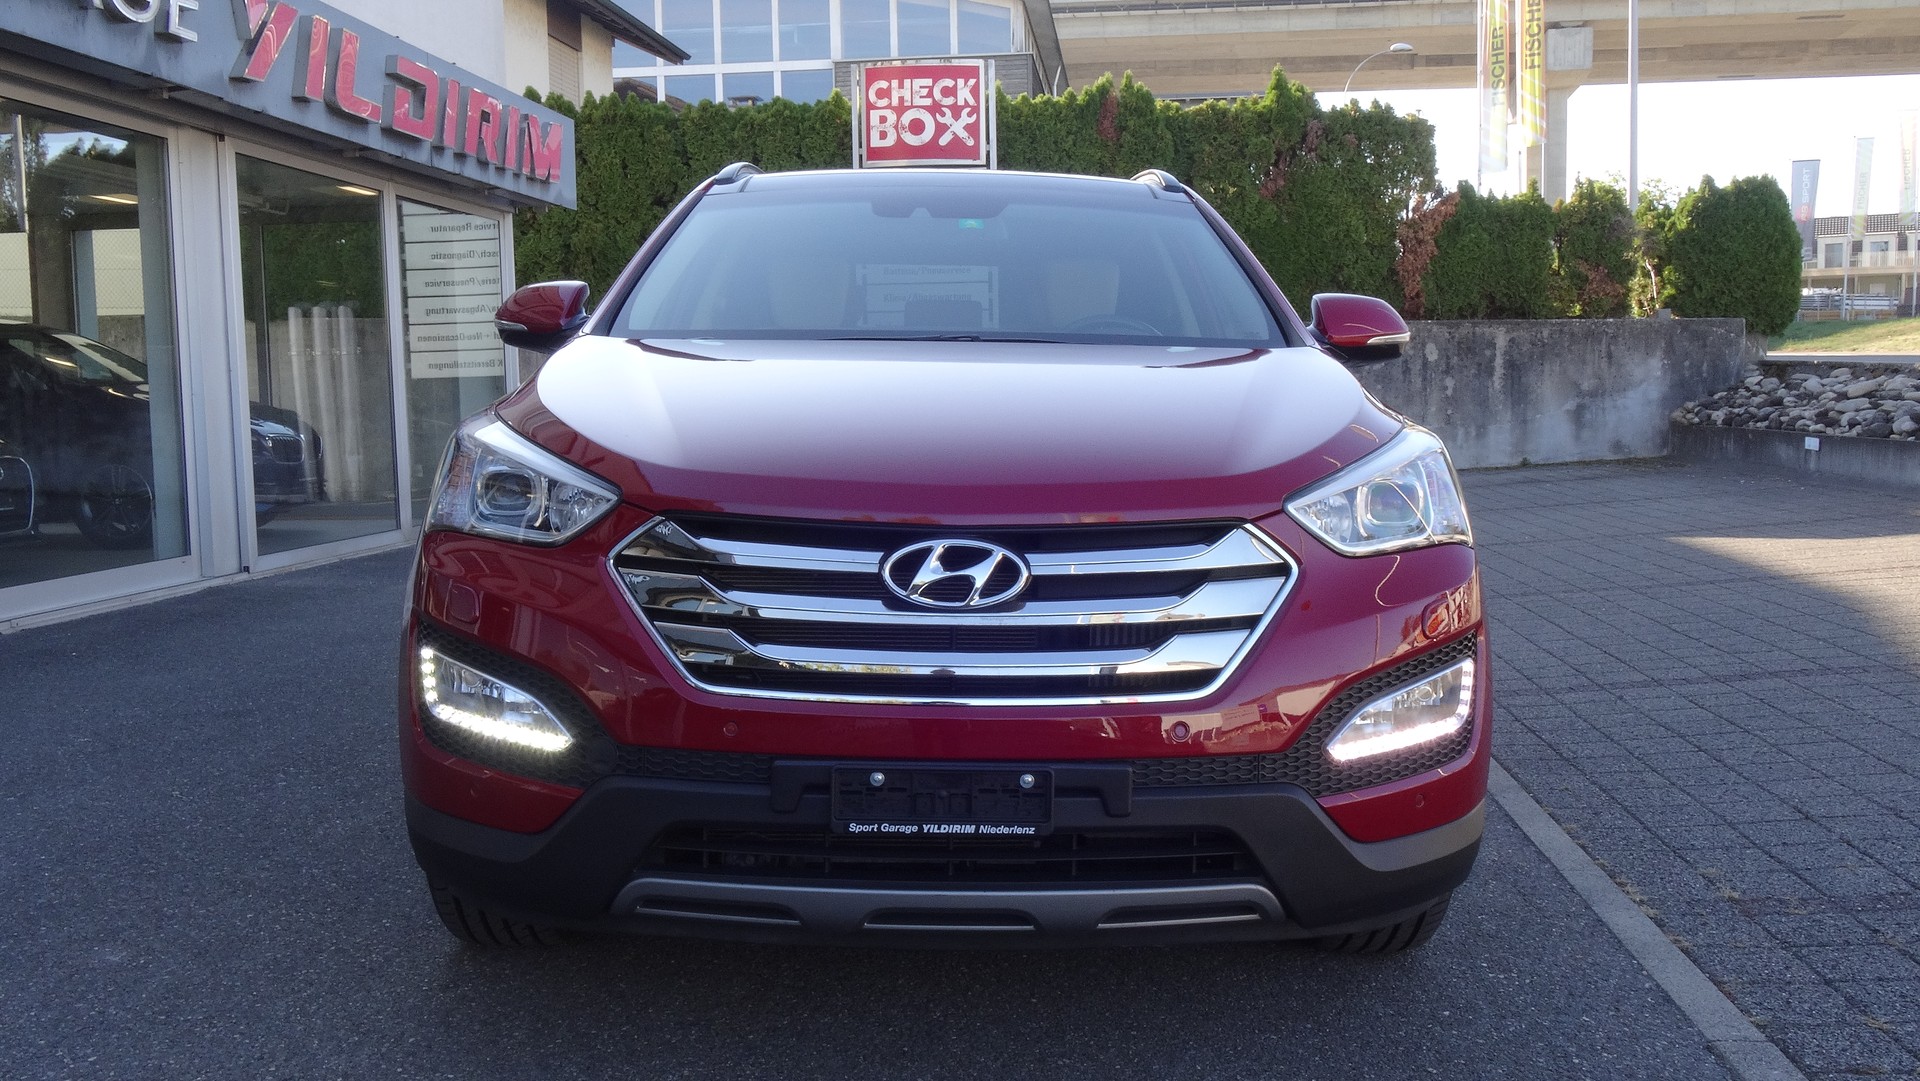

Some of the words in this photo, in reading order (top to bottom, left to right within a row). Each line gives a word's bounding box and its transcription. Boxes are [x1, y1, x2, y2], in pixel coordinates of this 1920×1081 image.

[1491, 26, 1506, 107] FISCHER
[233, 0, 564, 184] YILDIRIM
[868, 78, 977, 107] CHECK
[869, 107, 977, 148] BOX
[1802, 167, 1811, 203] SPORT
[848, 822, 878, 833] Sport
[881, 823, 918, 834] Garage
[922, 824, 976, 834] YILDIRIM
[979, 824, 1036, 835] Niederlenz
